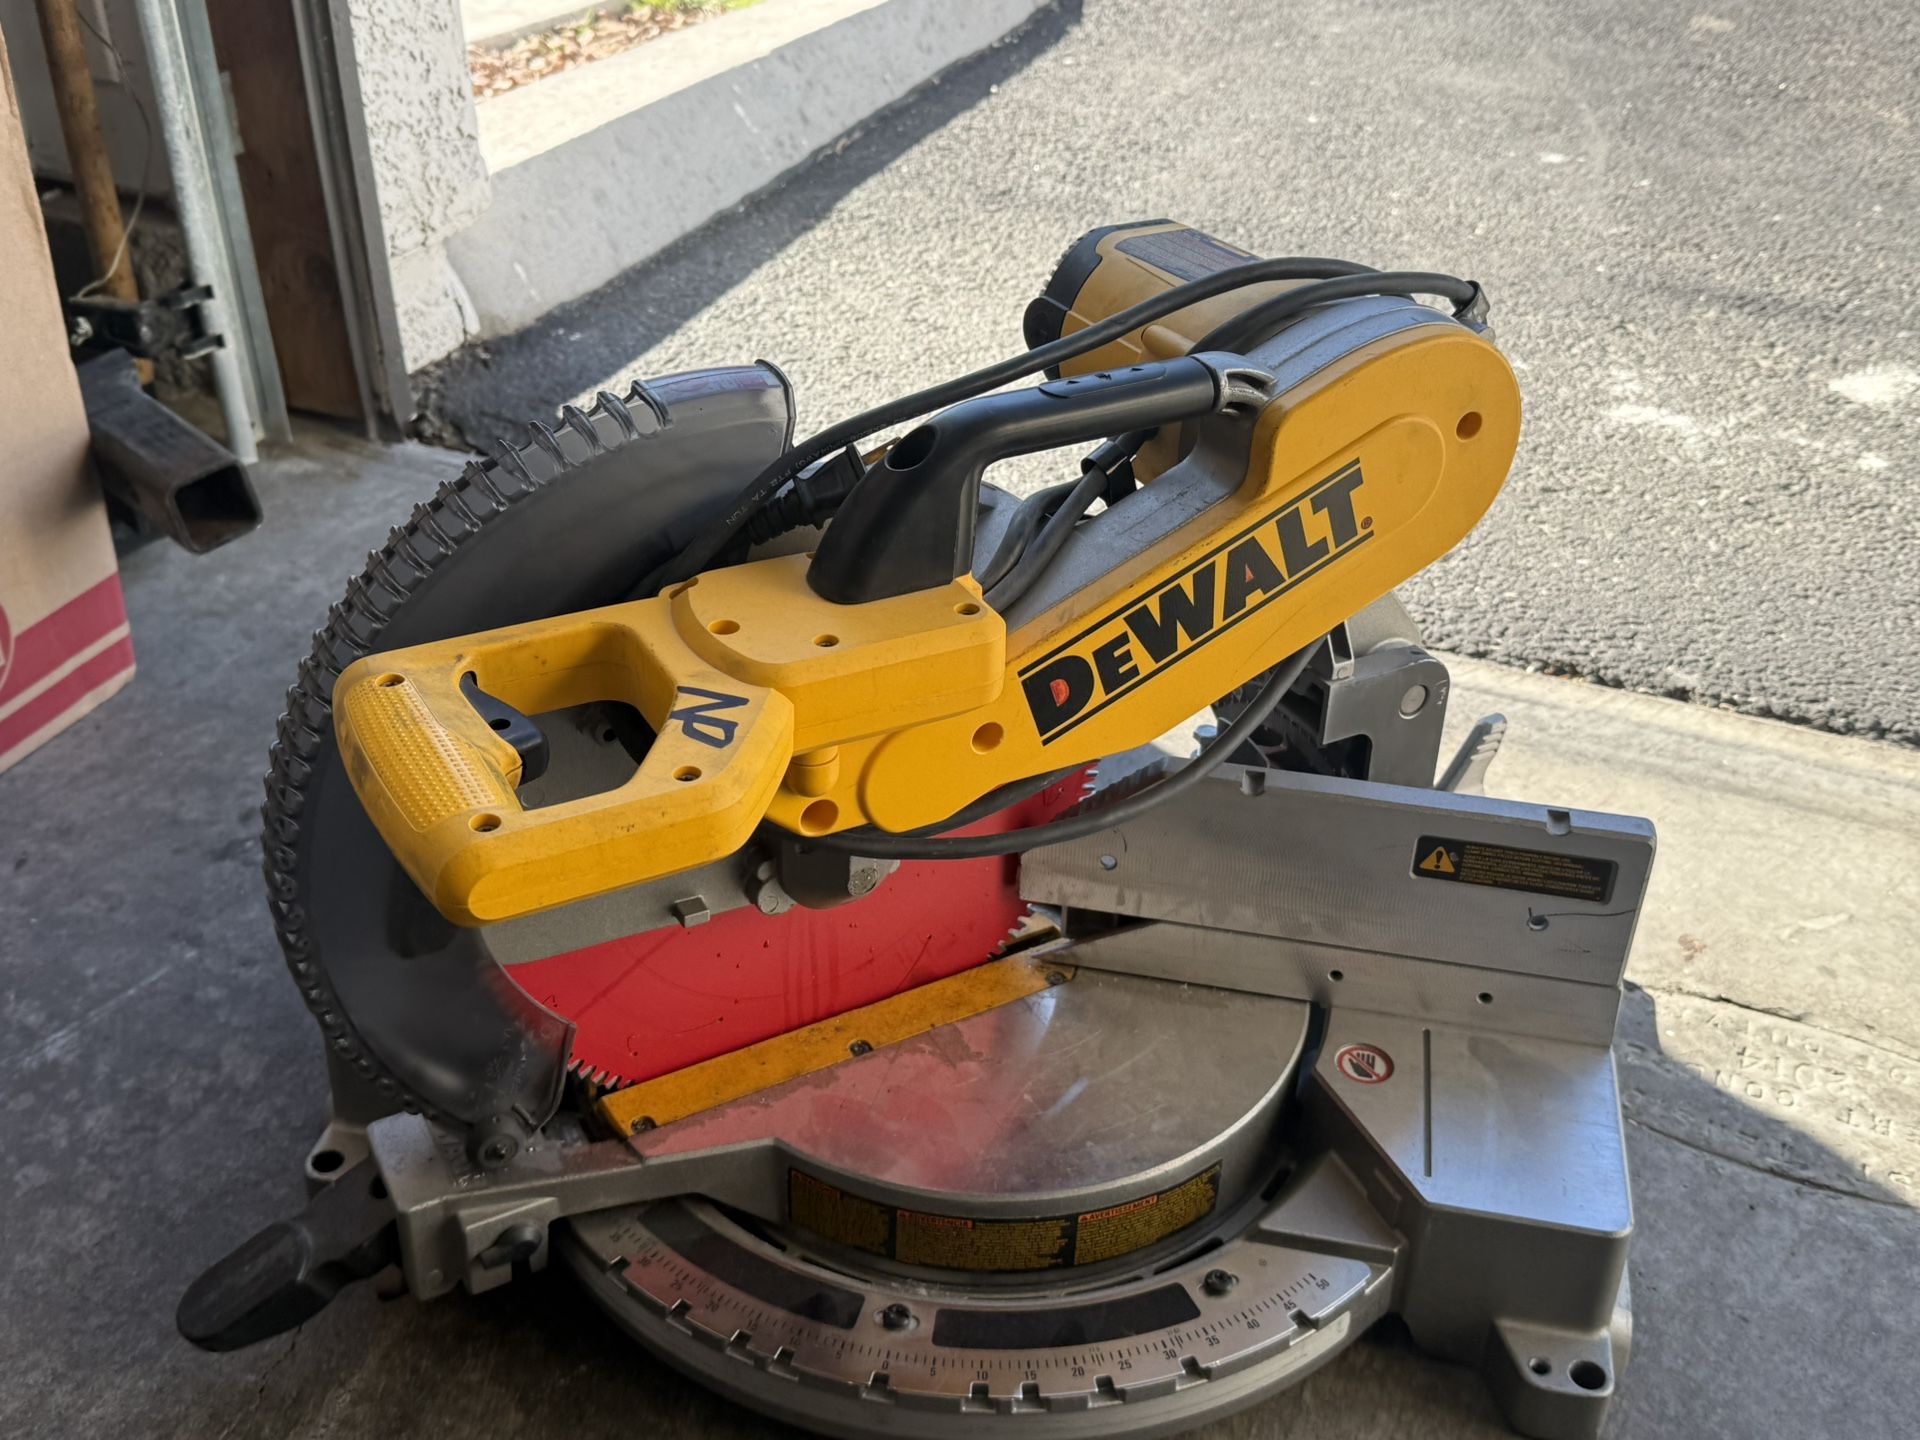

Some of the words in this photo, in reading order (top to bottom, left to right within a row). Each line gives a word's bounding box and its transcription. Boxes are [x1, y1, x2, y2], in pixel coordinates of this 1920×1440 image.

[1021, 466, 1364, 737] DEWALT
[881, 1360, 889, 1370] 0
[929, 1367, 937, 1377] 5
[976, 1370, 989, 1381] 10
[1024, 1369, 1037, 1381] 15
[1070, 1366, 1085, 1378] 20
[1118, 1359, 1133, 1371] 25
[1162, 1348, 1177, 1360] 30
[1205, 1334, 1220, 1347] 35
[1246, 1318, 1260, 1330] 40
[1283, 1300, 1297, 1311] 45
[1315, 1278, 1330, 1291] 50
